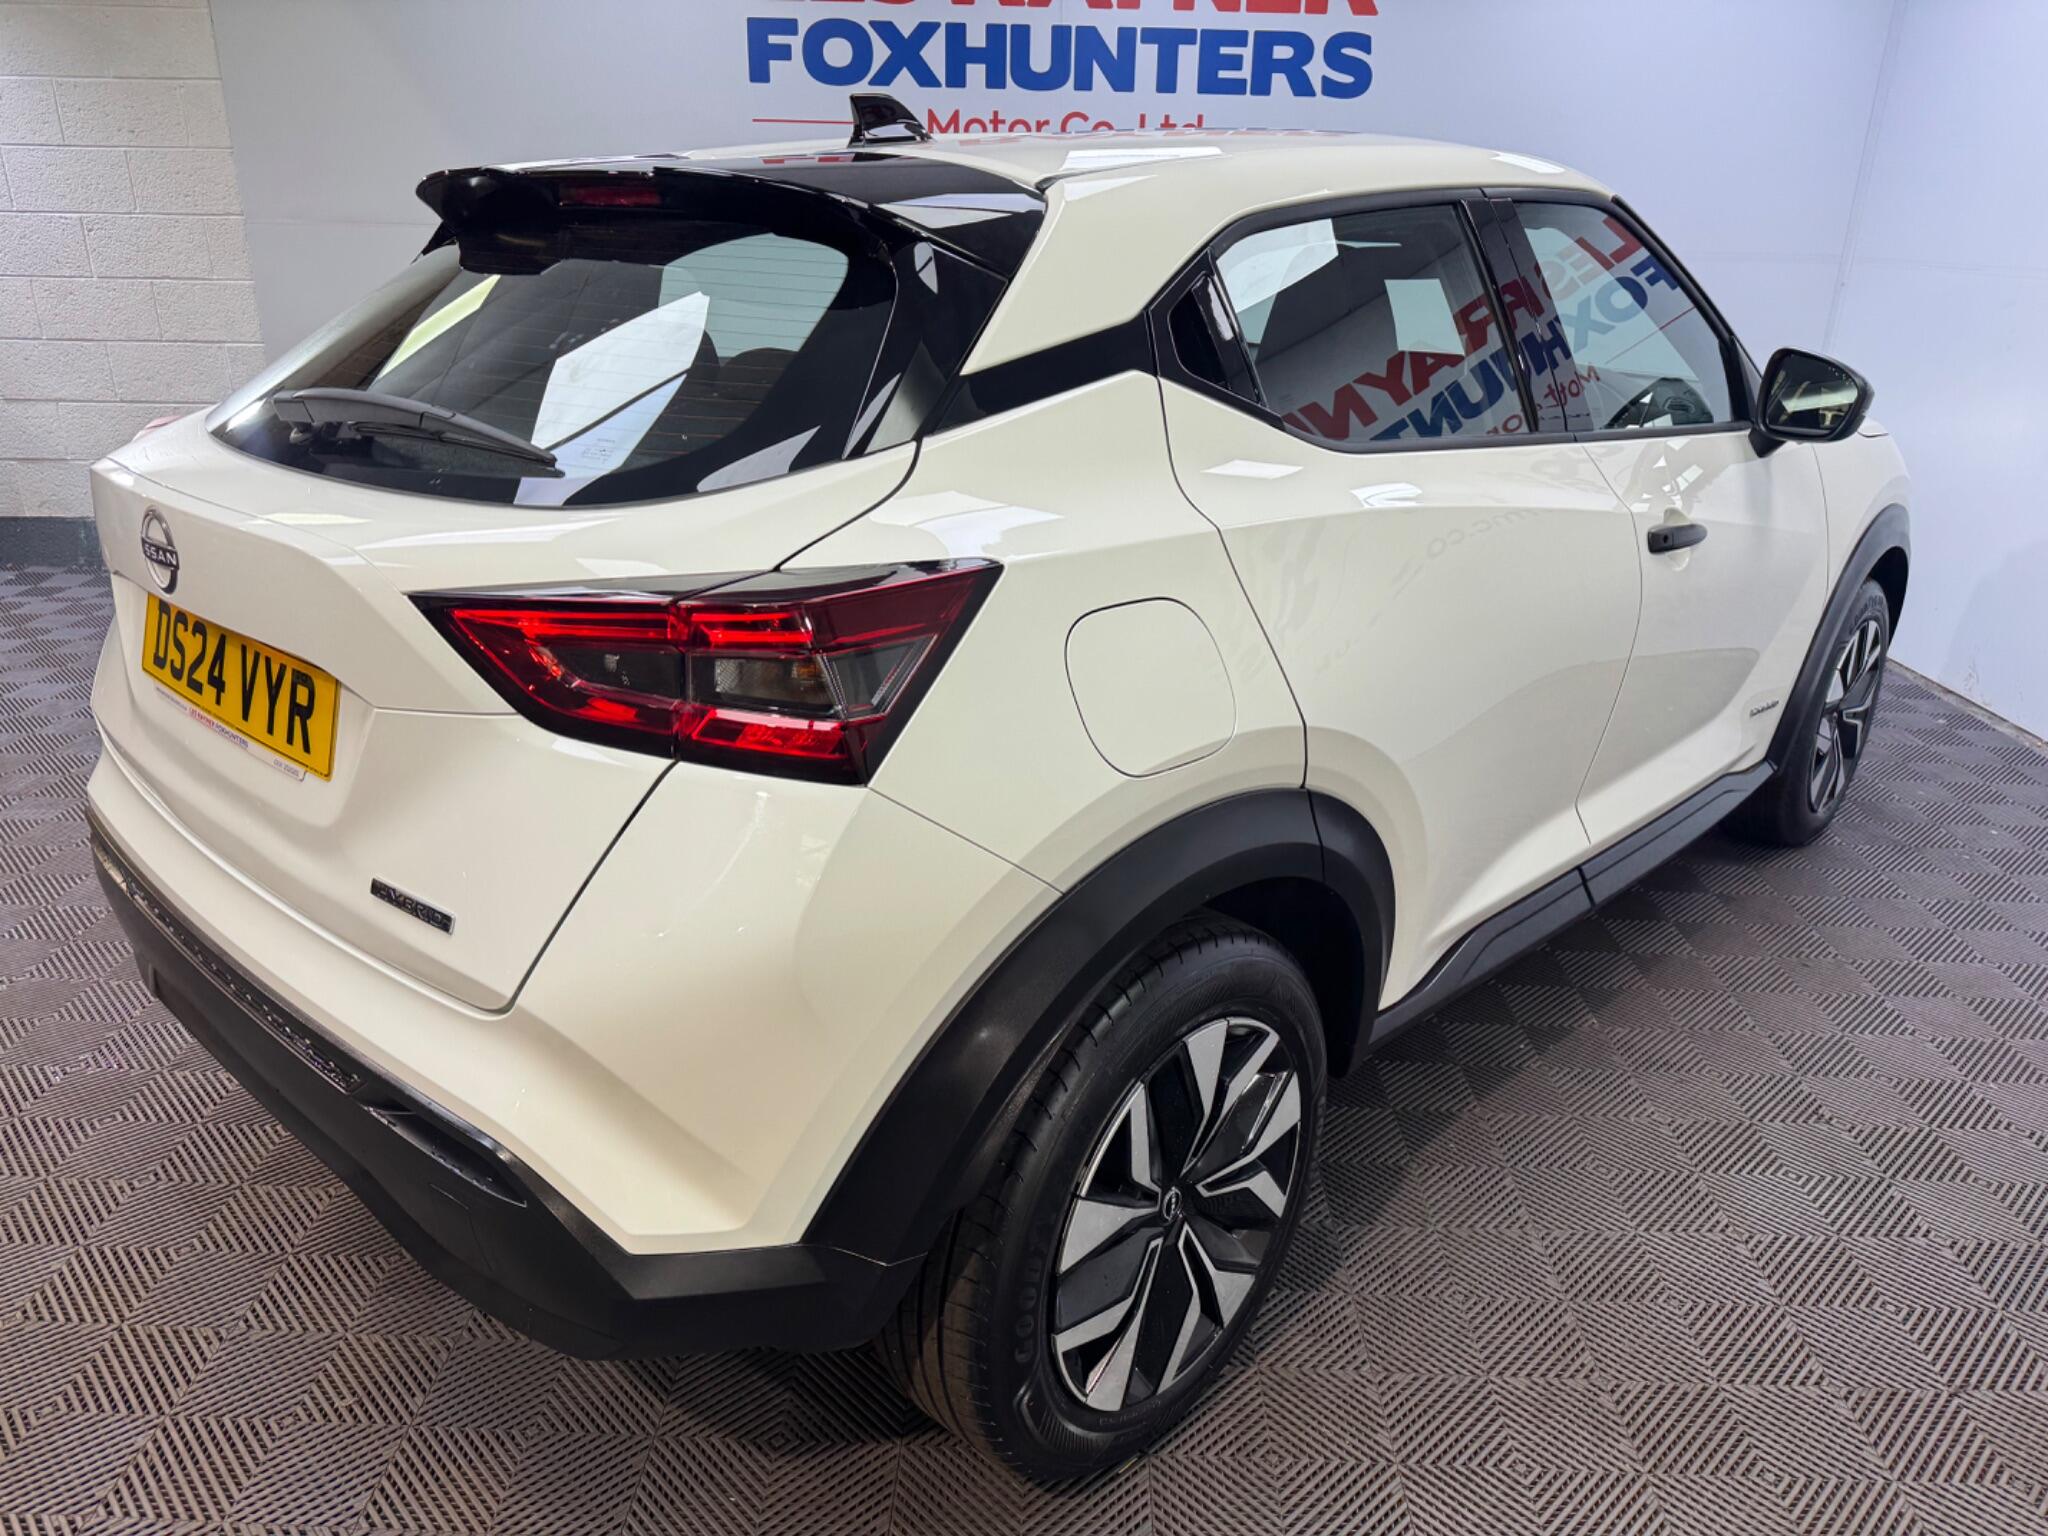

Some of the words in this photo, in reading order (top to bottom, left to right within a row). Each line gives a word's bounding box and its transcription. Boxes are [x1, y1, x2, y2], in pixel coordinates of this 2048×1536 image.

[747, 17, 1373, 99] FOXHUNTERS
[153, 598, 226, 706] DS24
[241, 644, 316, 755] VYR
